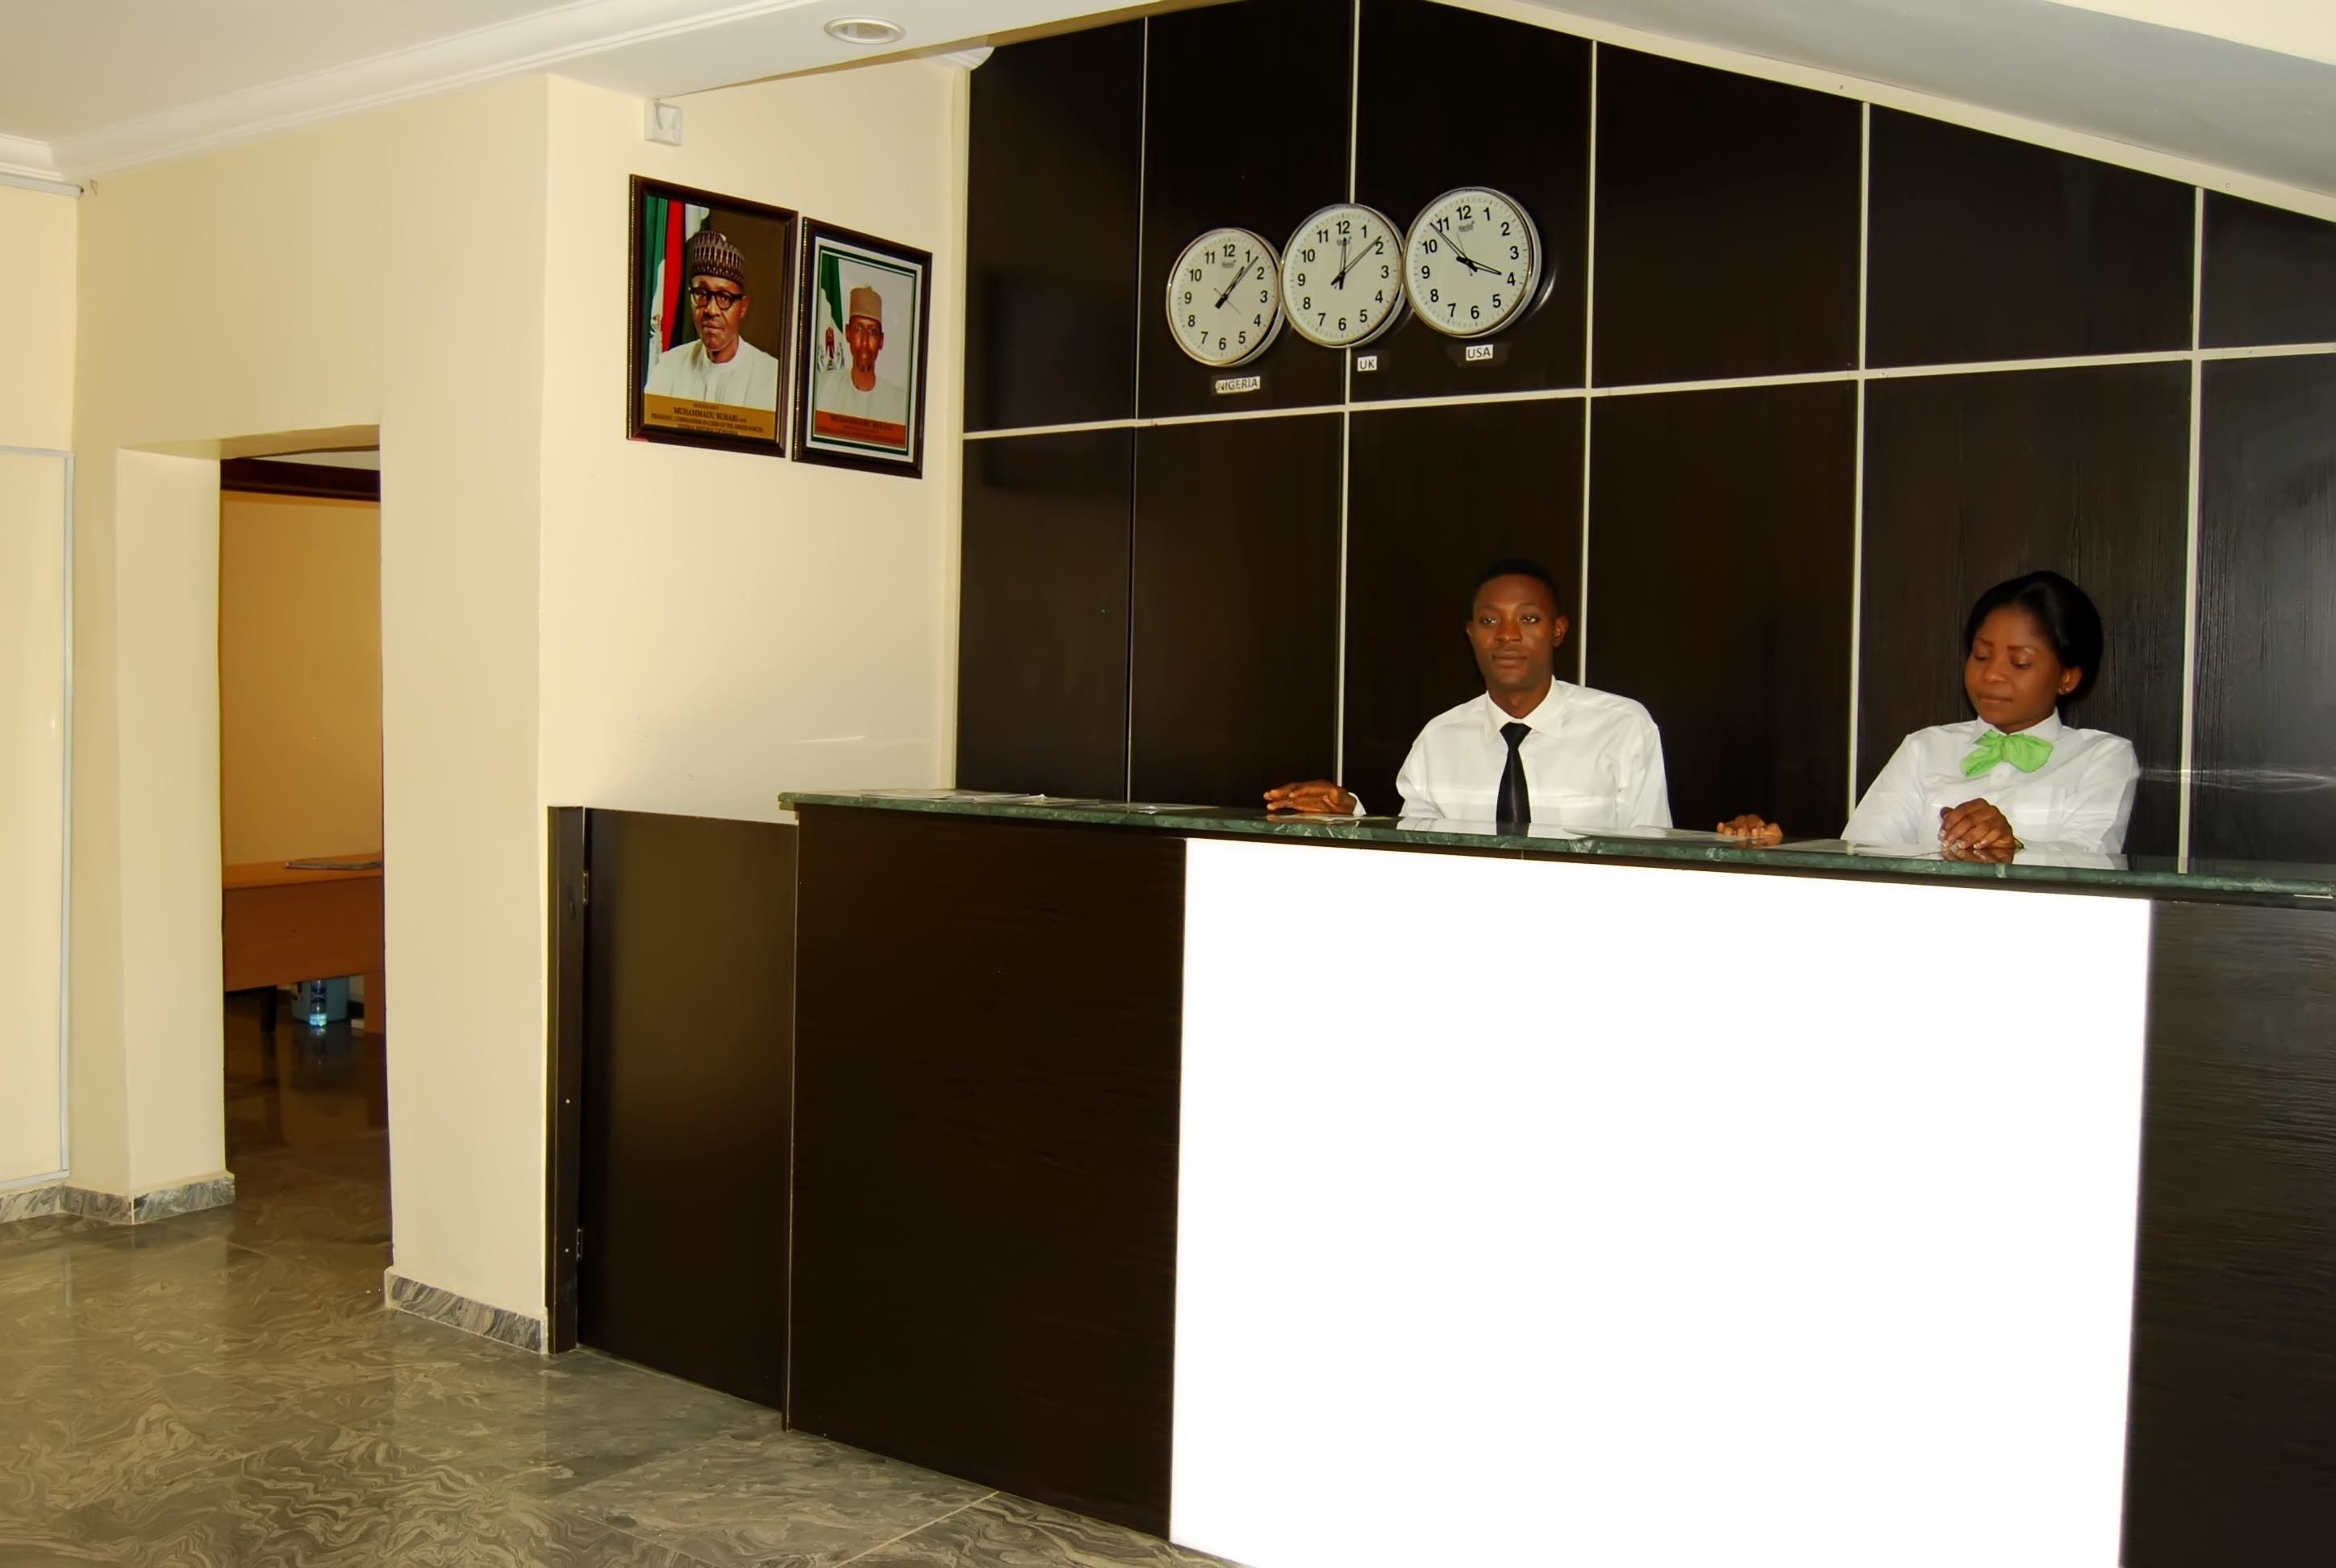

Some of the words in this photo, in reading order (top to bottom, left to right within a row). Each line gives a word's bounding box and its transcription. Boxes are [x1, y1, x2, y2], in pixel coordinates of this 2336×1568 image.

[1455, 204, 1472, 221] 12
[1483, 206, 1491, 222] 1
[1336, 219, 1351, 236] 12
[1361, 224, 1367, 239] 1
[1436, 216, 1450, 232] 11
[1500, 221, 1511, 237] 2
[1316, 228, 1329, 244] 11
[1222, 244, 1236, 258] 12
[1374, 240, 1384, 256] 2
[1421, 239, 1438, 255] 10
[1509, 245, 1520, 261] 3
[1204, 251, 1216, 265] 11
[1245, 249, 1251, 264] 1
[1300, 248, 1316, 263] 10
[1189, 268, 1203, 282] 10
[1256, 266, 1265, 281] 2
[1380, 265, 1390, 279] 3
[1420, 265, 1431, 280] 9
[1506, 271, 1516, 286] 4
[1297, 273, 1306, 287] 9
[1184, 291, 1192, 305] 9
[1259, 290, 1269, 304] 3
[1374, 290, 1384, 304] 4
[1429, 288, 1440, 303] 8
[1492, 293, 1502, 309] 5
[1303, 296, 1312, 311] 8
[1446, 302, 1457, 318] 7
[1253, 313, 1262, 327] 4
[1317, 312, 1327, 327] 7
[1359, 308, 1368, 323] 5
[1470, 305, 1480, 320] 6
[1187, 314, 1195, 328] 8
[1337, 317, 1347, 332] 6
[1200, 331, 1209, 344] 7
[1218, 337, 1227, 351] 6
[1237, 330, 1246, 345] 5
[1467, 347, 1491, 359] USA
[1359, 359, 1374, 369] UK
[1217, 378, 1258, 391] NIGERIA
